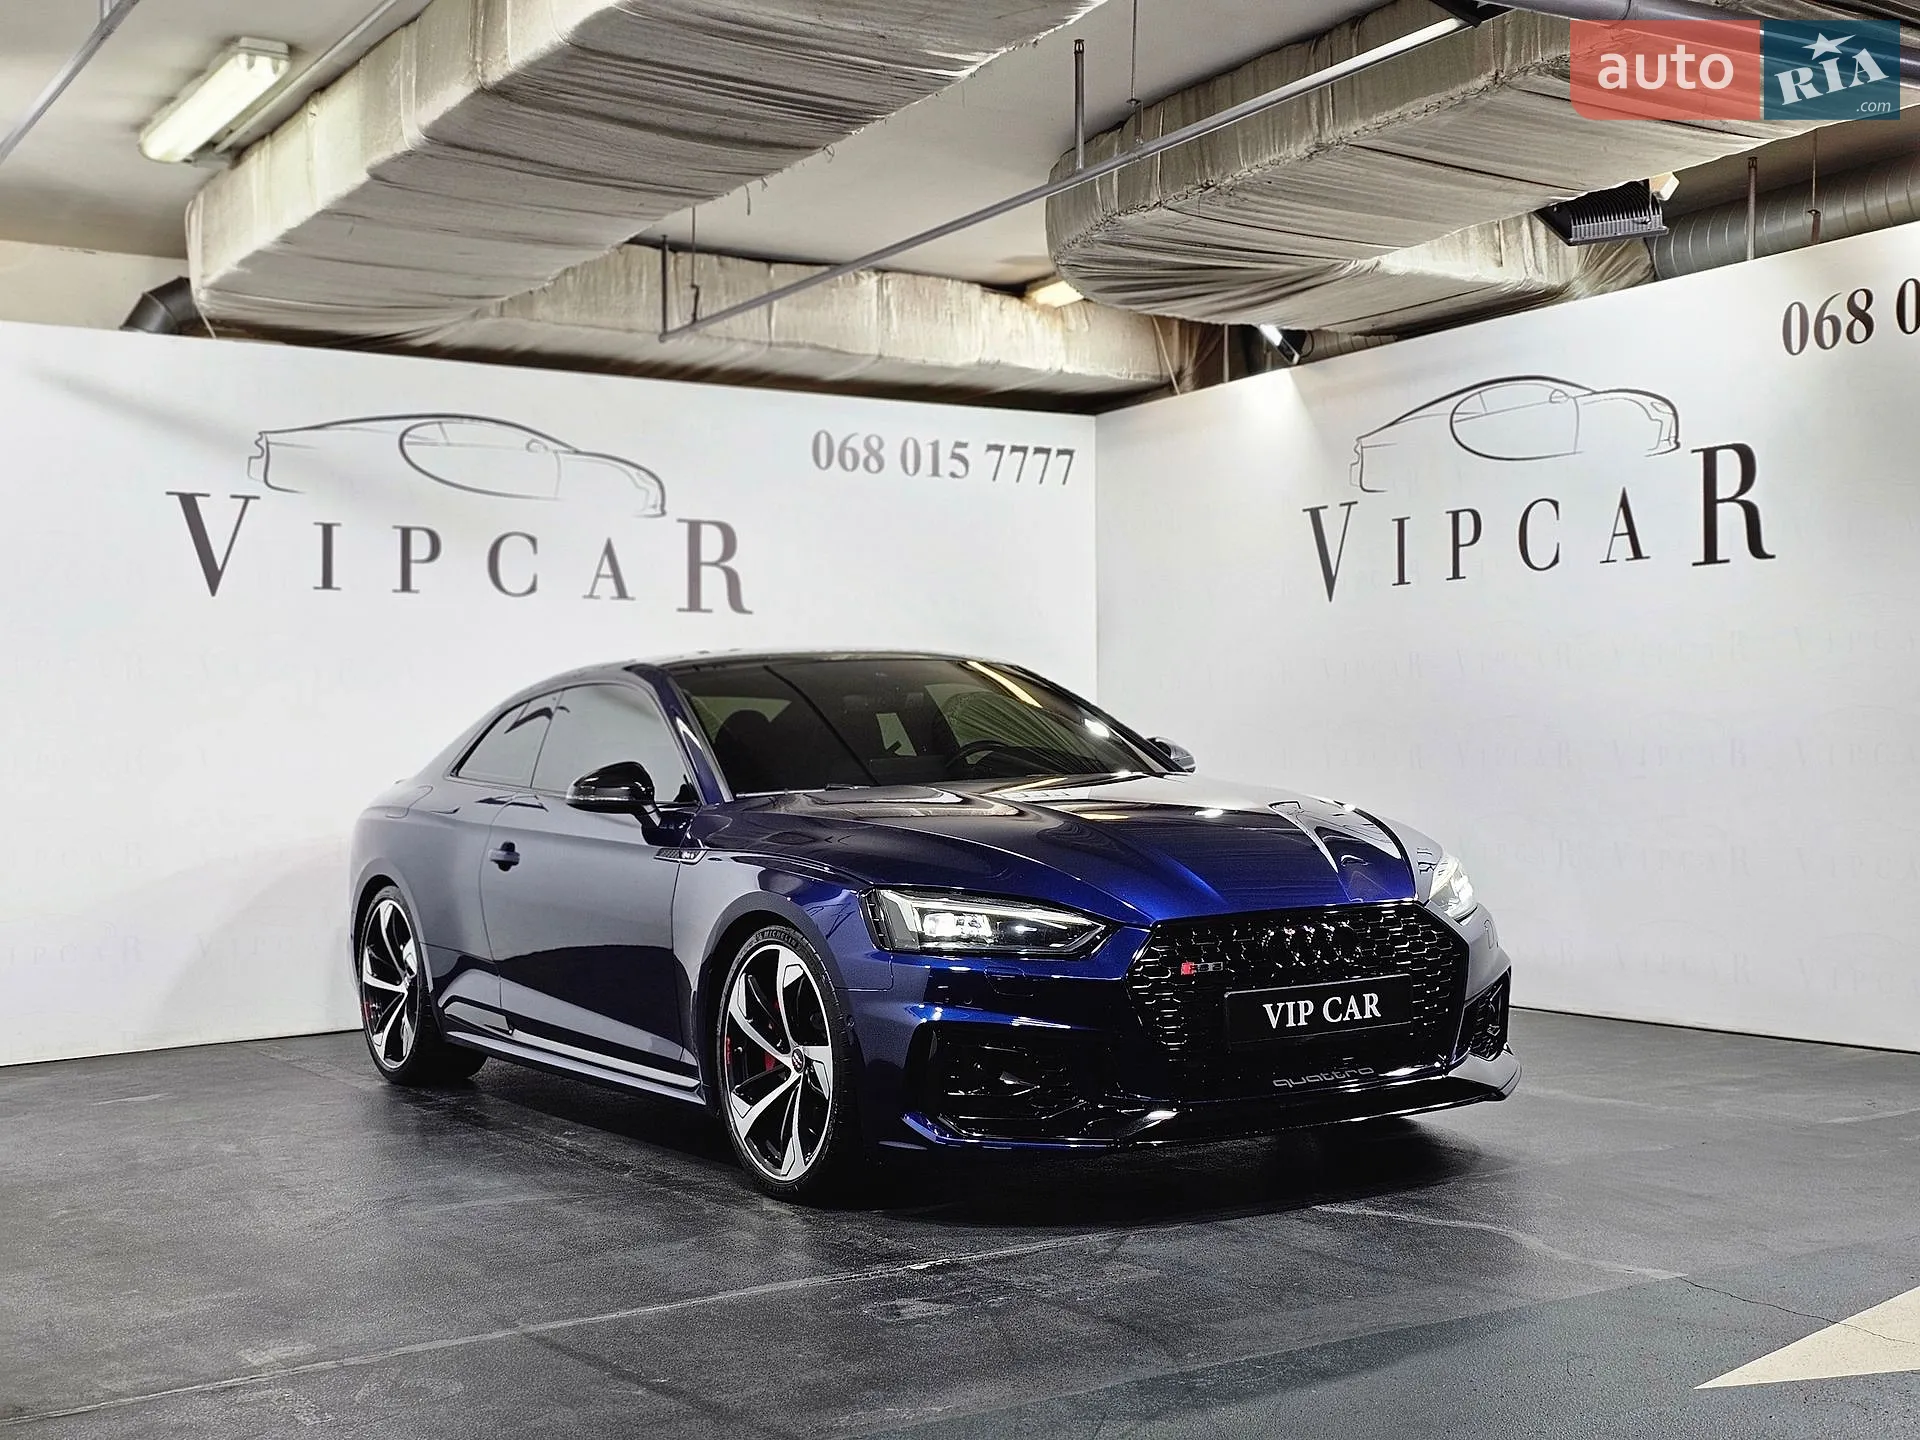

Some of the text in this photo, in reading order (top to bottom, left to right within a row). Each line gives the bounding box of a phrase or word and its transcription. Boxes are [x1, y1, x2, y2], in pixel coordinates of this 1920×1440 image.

[1782, 289, 1875, 356] 068
[811, 429, 1076, 485] 068 015 7777
[1302, 442, 1777, 603] VIPCAR
[165, 491, 754, 614] VIPCAR
[764, 930, 797, 947] MICHELIN
[1262, 992, 1382, 1029] VIP CAR
[1272, 1067, 1375, 1088] quattro
